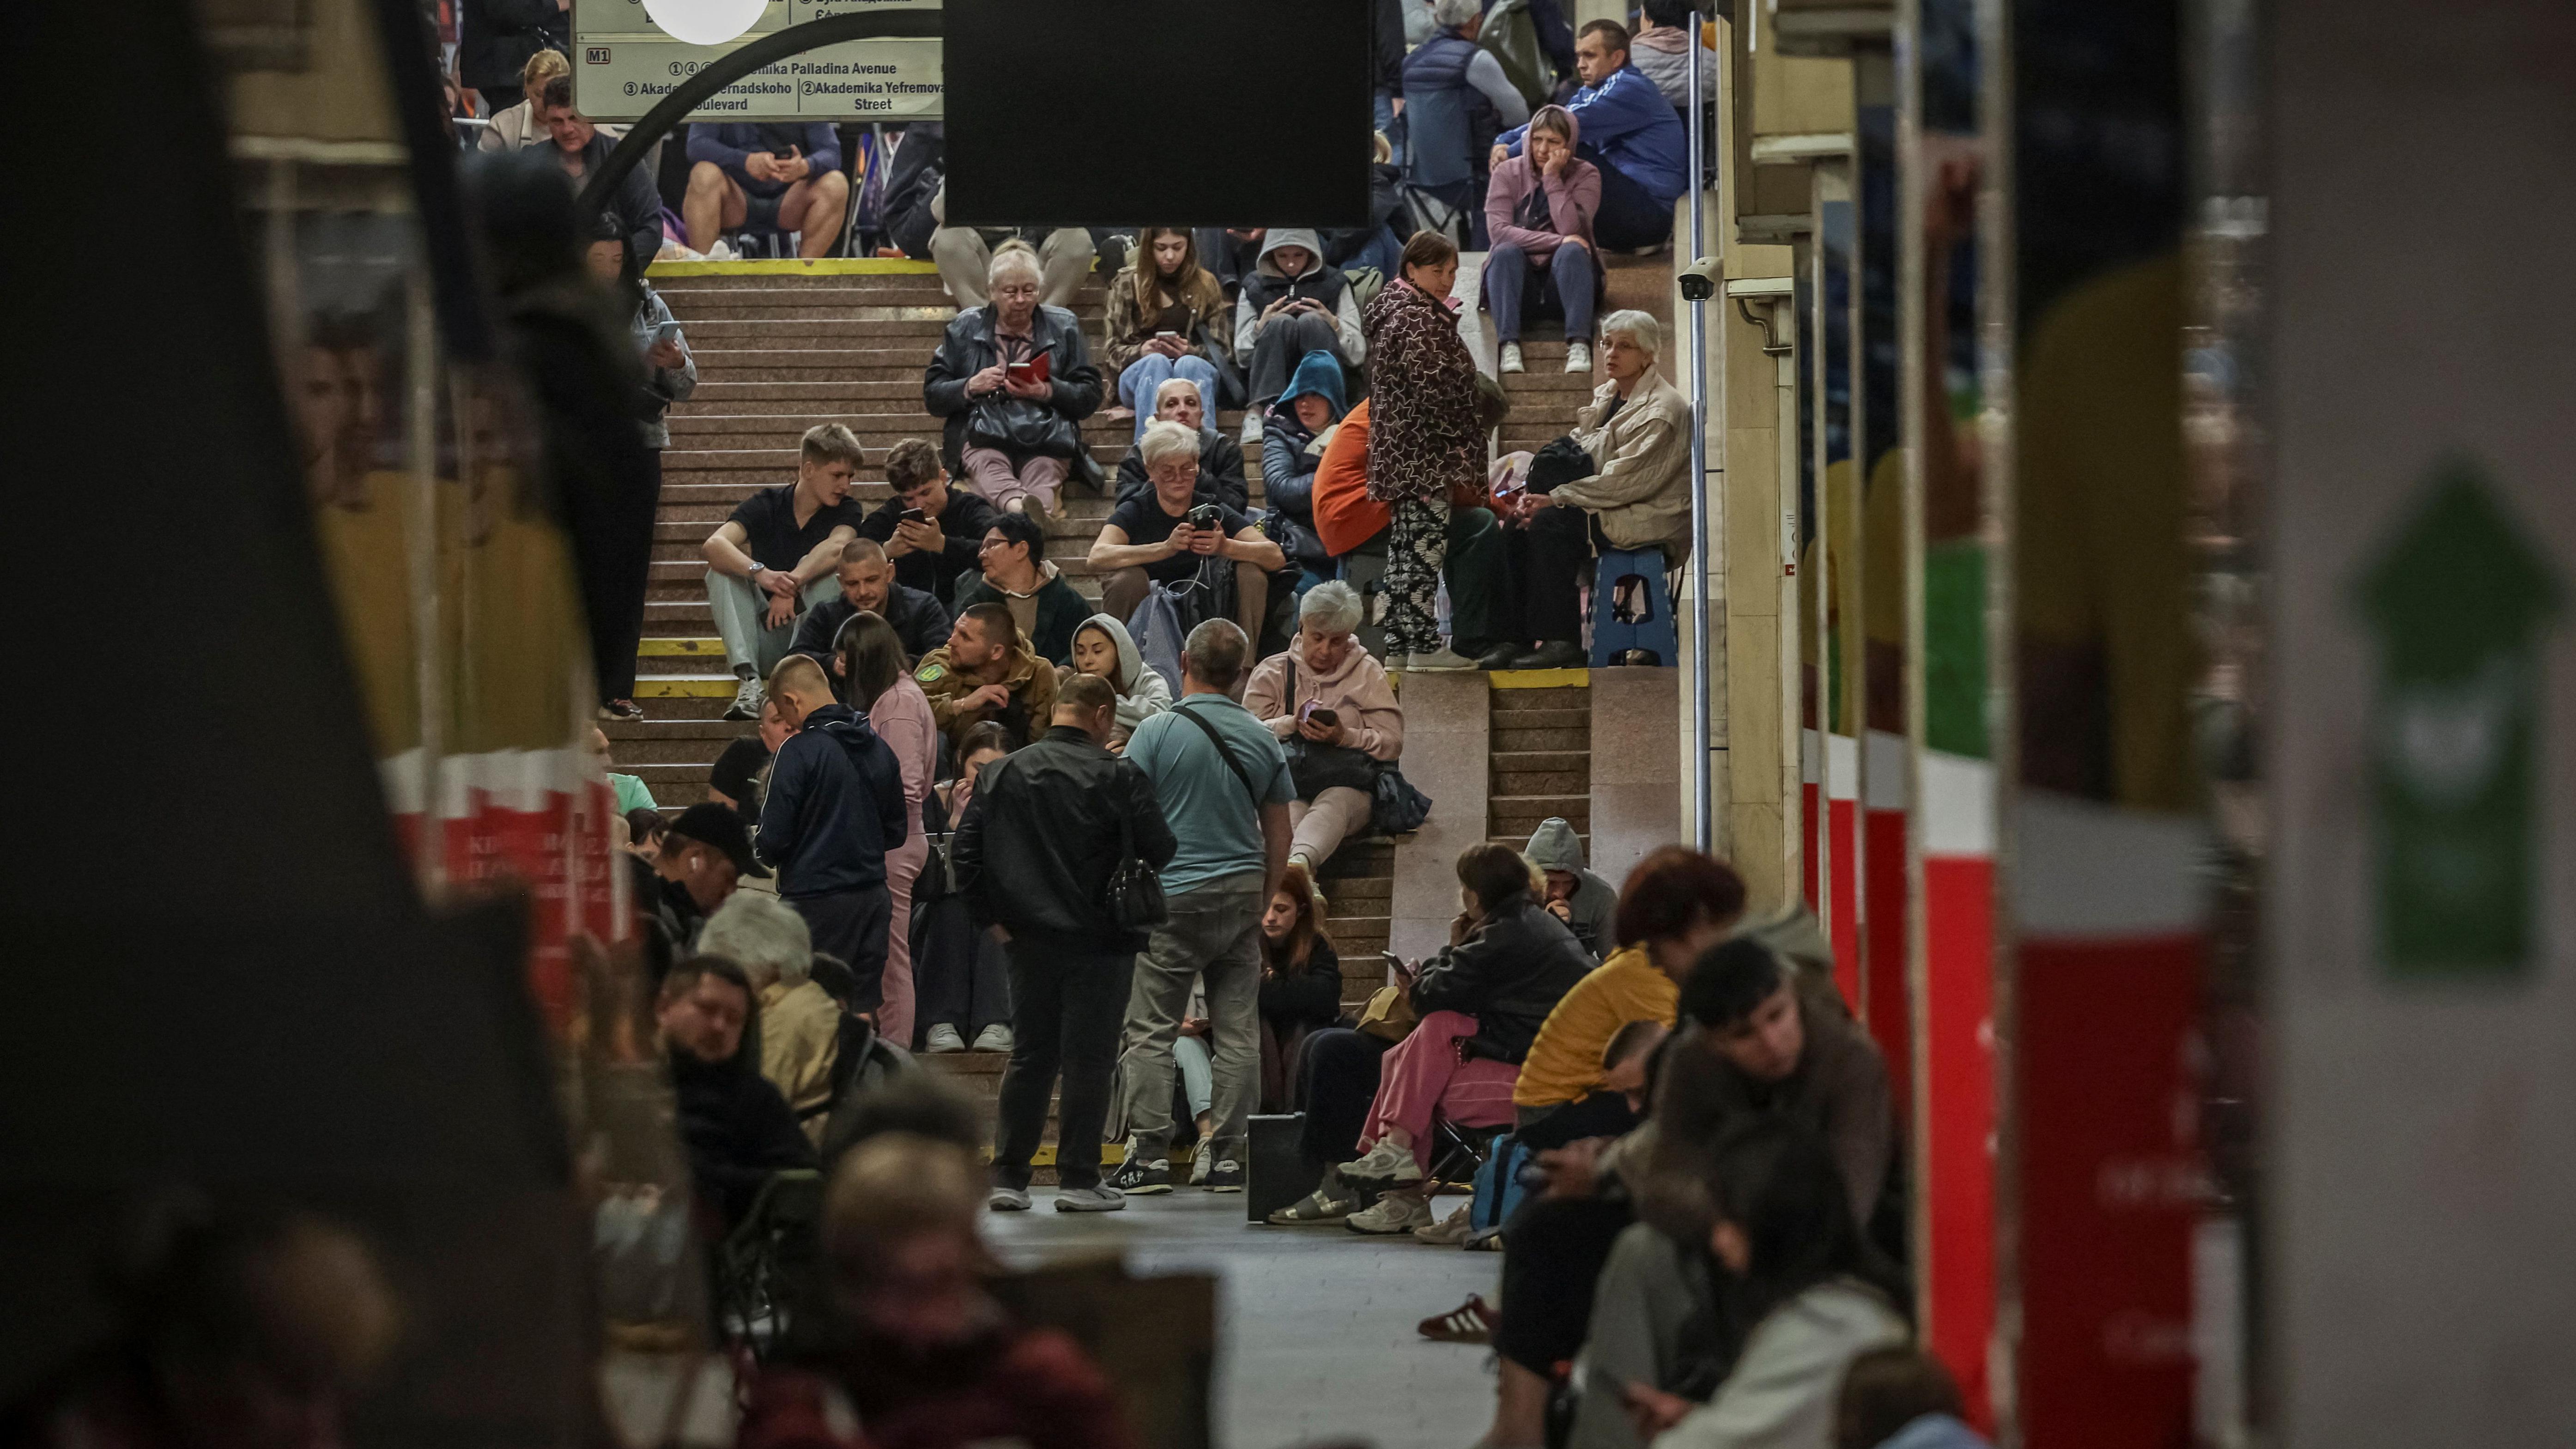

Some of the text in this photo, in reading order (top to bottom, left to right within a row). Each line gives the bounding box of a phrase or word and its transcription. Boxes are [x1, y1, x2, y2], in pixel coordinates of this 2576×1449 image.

[589, 50, 609, 62] M1
[791, 63, 849, 74] Palladina
[852, 63, 897, 74] Avenue
[721, 82, 791, 94] ernadskoho
[815, 82, 882, 94] Akademika
[696, 98, 747, 110] oulevard
[855, 98, 892, 110] Street
